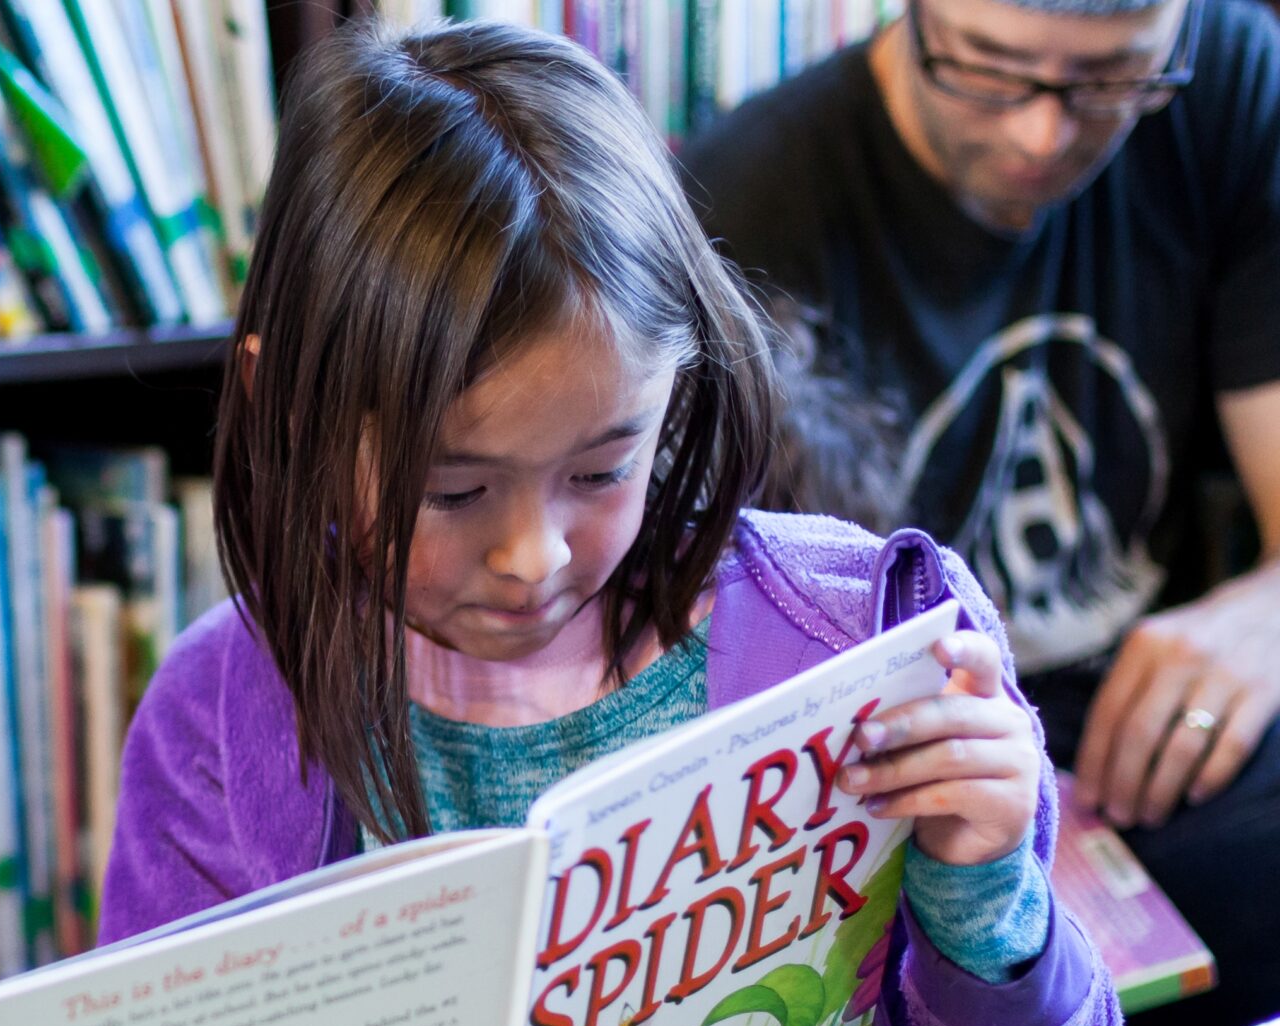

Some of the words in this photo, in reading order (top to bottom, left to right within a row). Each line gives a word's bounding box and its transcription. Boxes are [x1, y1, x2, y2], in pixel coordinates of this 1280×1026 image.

[648, 755, 709, 794] Cronin
[727, 708, 798, 755] Pictures
[801, 691, 825, 718] by
[829, 670, 881, 704] Harry
[885, 647, 926, 676] Bliss
[536, 697, 881, 972] DIARY
[61, 991, 121, 1021] This
[131, 981, 153, 1001] is
[162, 965, 205, 992] the
[214, 943, 283, 976] diary
[338, 908, 368, 939] of
[373, 912, 388, 928] a
